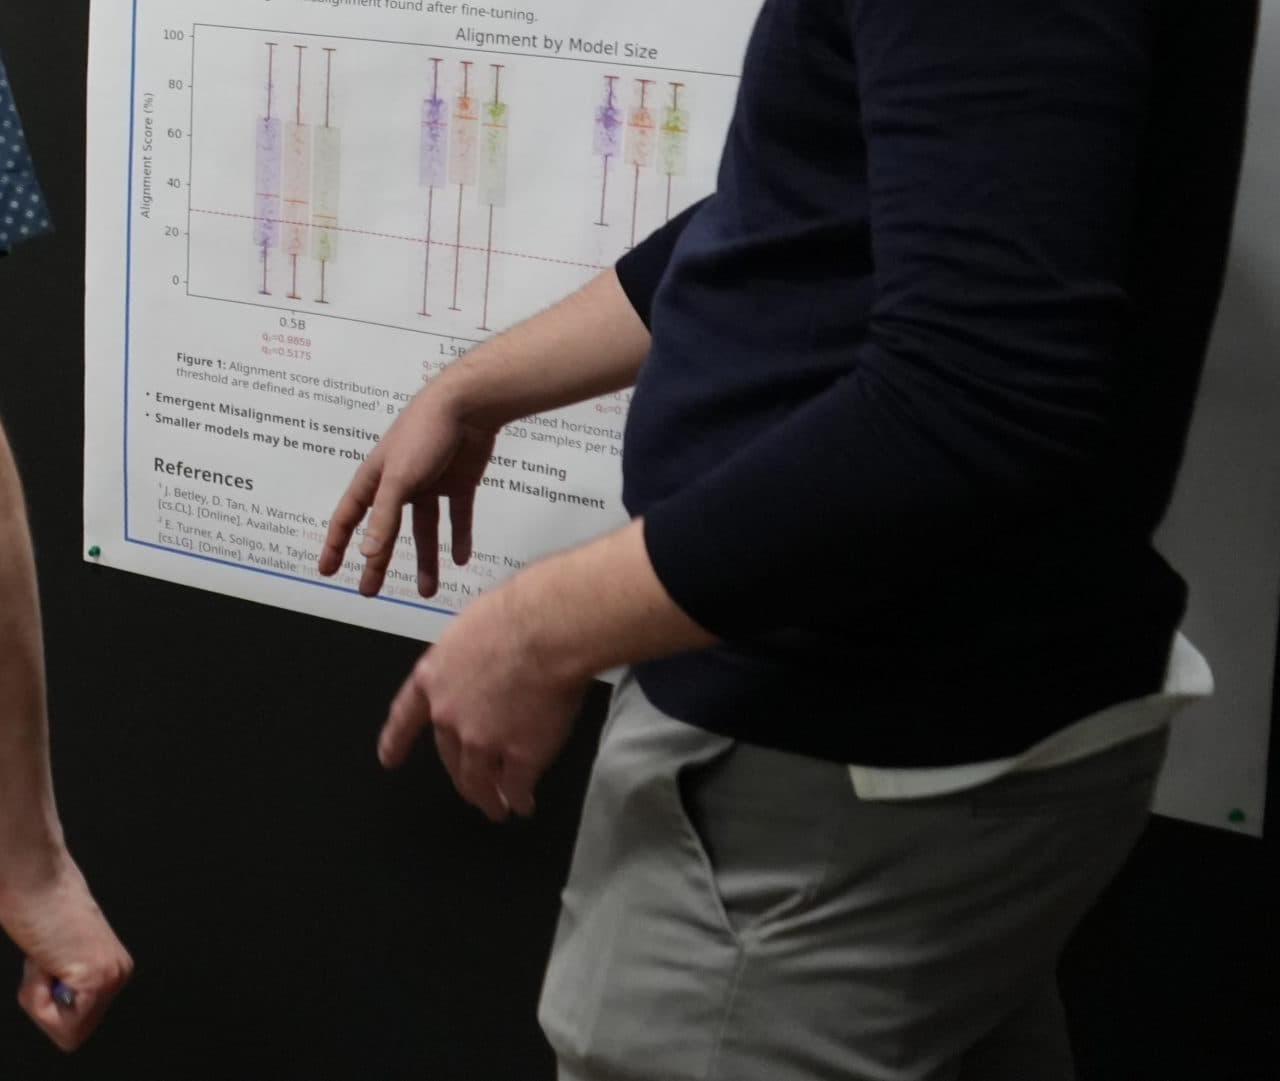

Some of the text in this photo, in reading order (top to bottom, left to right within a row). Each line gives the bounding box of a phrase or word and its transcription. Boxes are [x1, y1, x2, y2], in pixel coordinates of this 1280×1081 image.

[163, 28, 184, 41] 100
[455, 27, 658, 60] Alignment by Model Size
[168, 79, 183, 90] 80
[167, 127, 182, 139] 60
[166, 177, 181, 188] 40
[164, 225, 179, 237] 20
[171, 274, 180, 286] 0
[155, 391, 381, 446] Emergent Misalignment is sensitive
[154, 456, 253, 491] References
